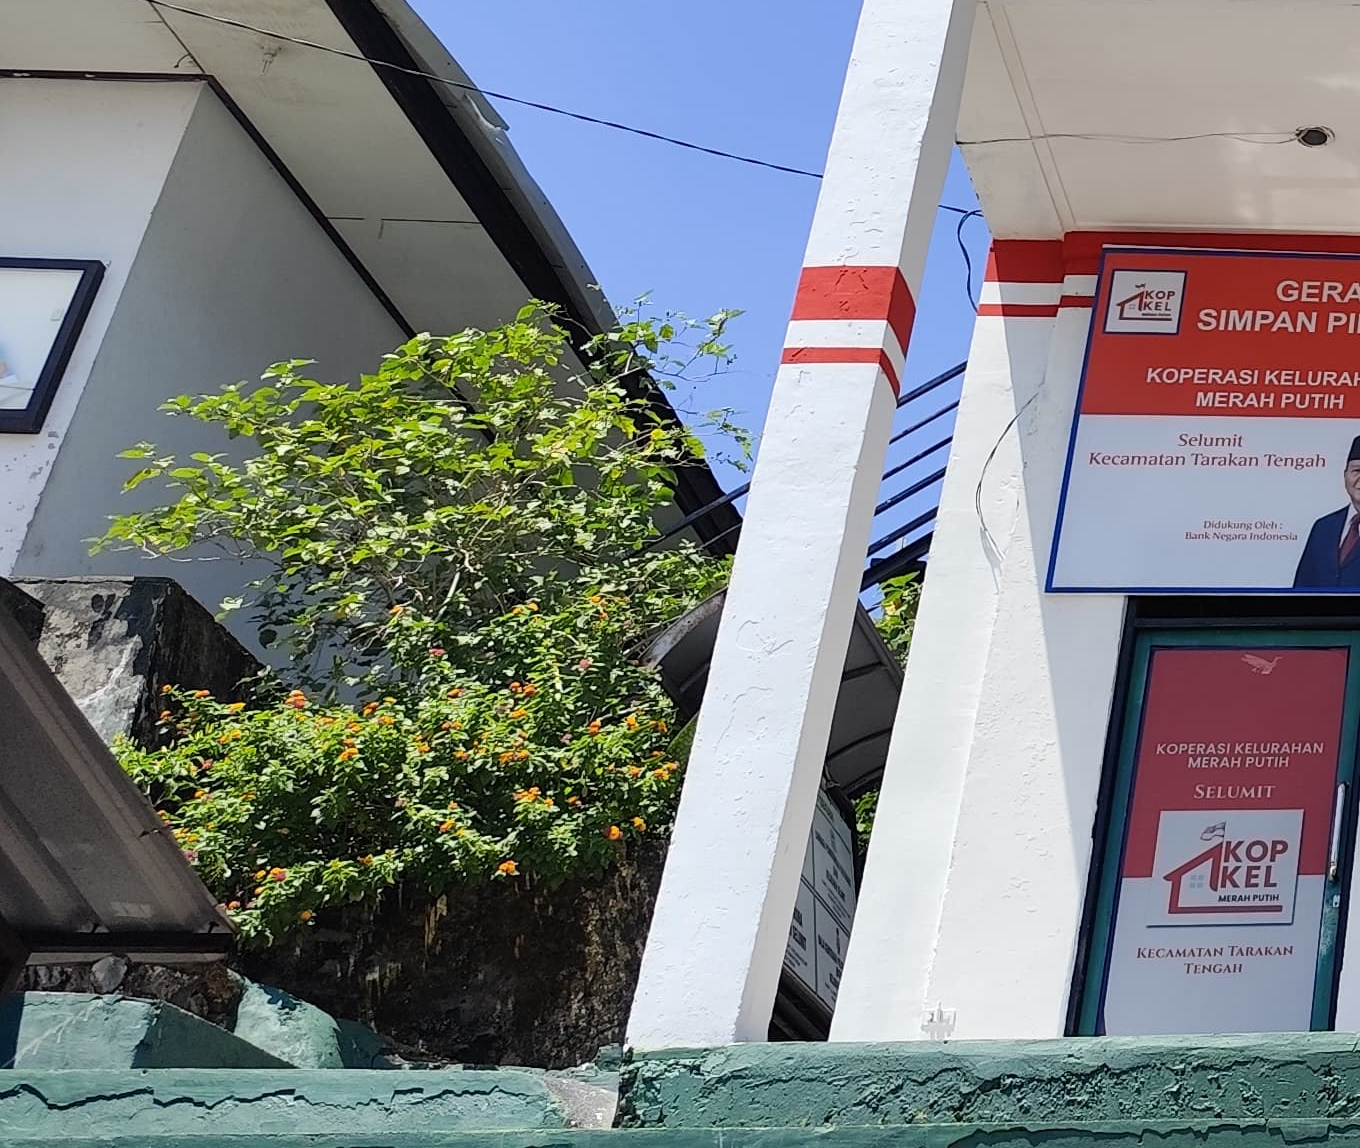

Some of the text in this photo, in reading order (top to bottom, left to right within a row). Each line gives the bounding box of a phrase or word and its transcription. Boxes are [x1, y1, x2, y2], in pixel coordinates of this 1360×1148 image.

[1145, 290, 1176, 300] KOP
[1143, 301, 1172, 311] KEL
[1197, 309, 1317, 333] SIMPAN
[1146, 368, 1259, 385] KOPERASI
[1196, 391, 1345, 409] MERAH PUTIH
[1177, 433, 1243, 448] Selumit
[1089, 452, 1327, 470] Kecamatan Tarakan Tengah
[1203, 520, 1252, 531] Didukung
[1254, 521, 1278, 530] Oleh
[1184, 532, 1298, 542] Bank Negara Indonesia
[1156, 742, 1324, 755] KOPERASI KELURAHAN
[1187, 756, 1290, 768] MERAH PUTIH
[1193, 784, 1276, 799] SELUMIT
[1223, 839, 1289, 863] KOP
[1220, 865, 1278, 888] KEL
[1218, 893, 1280, 902] MERAH PUTIH
